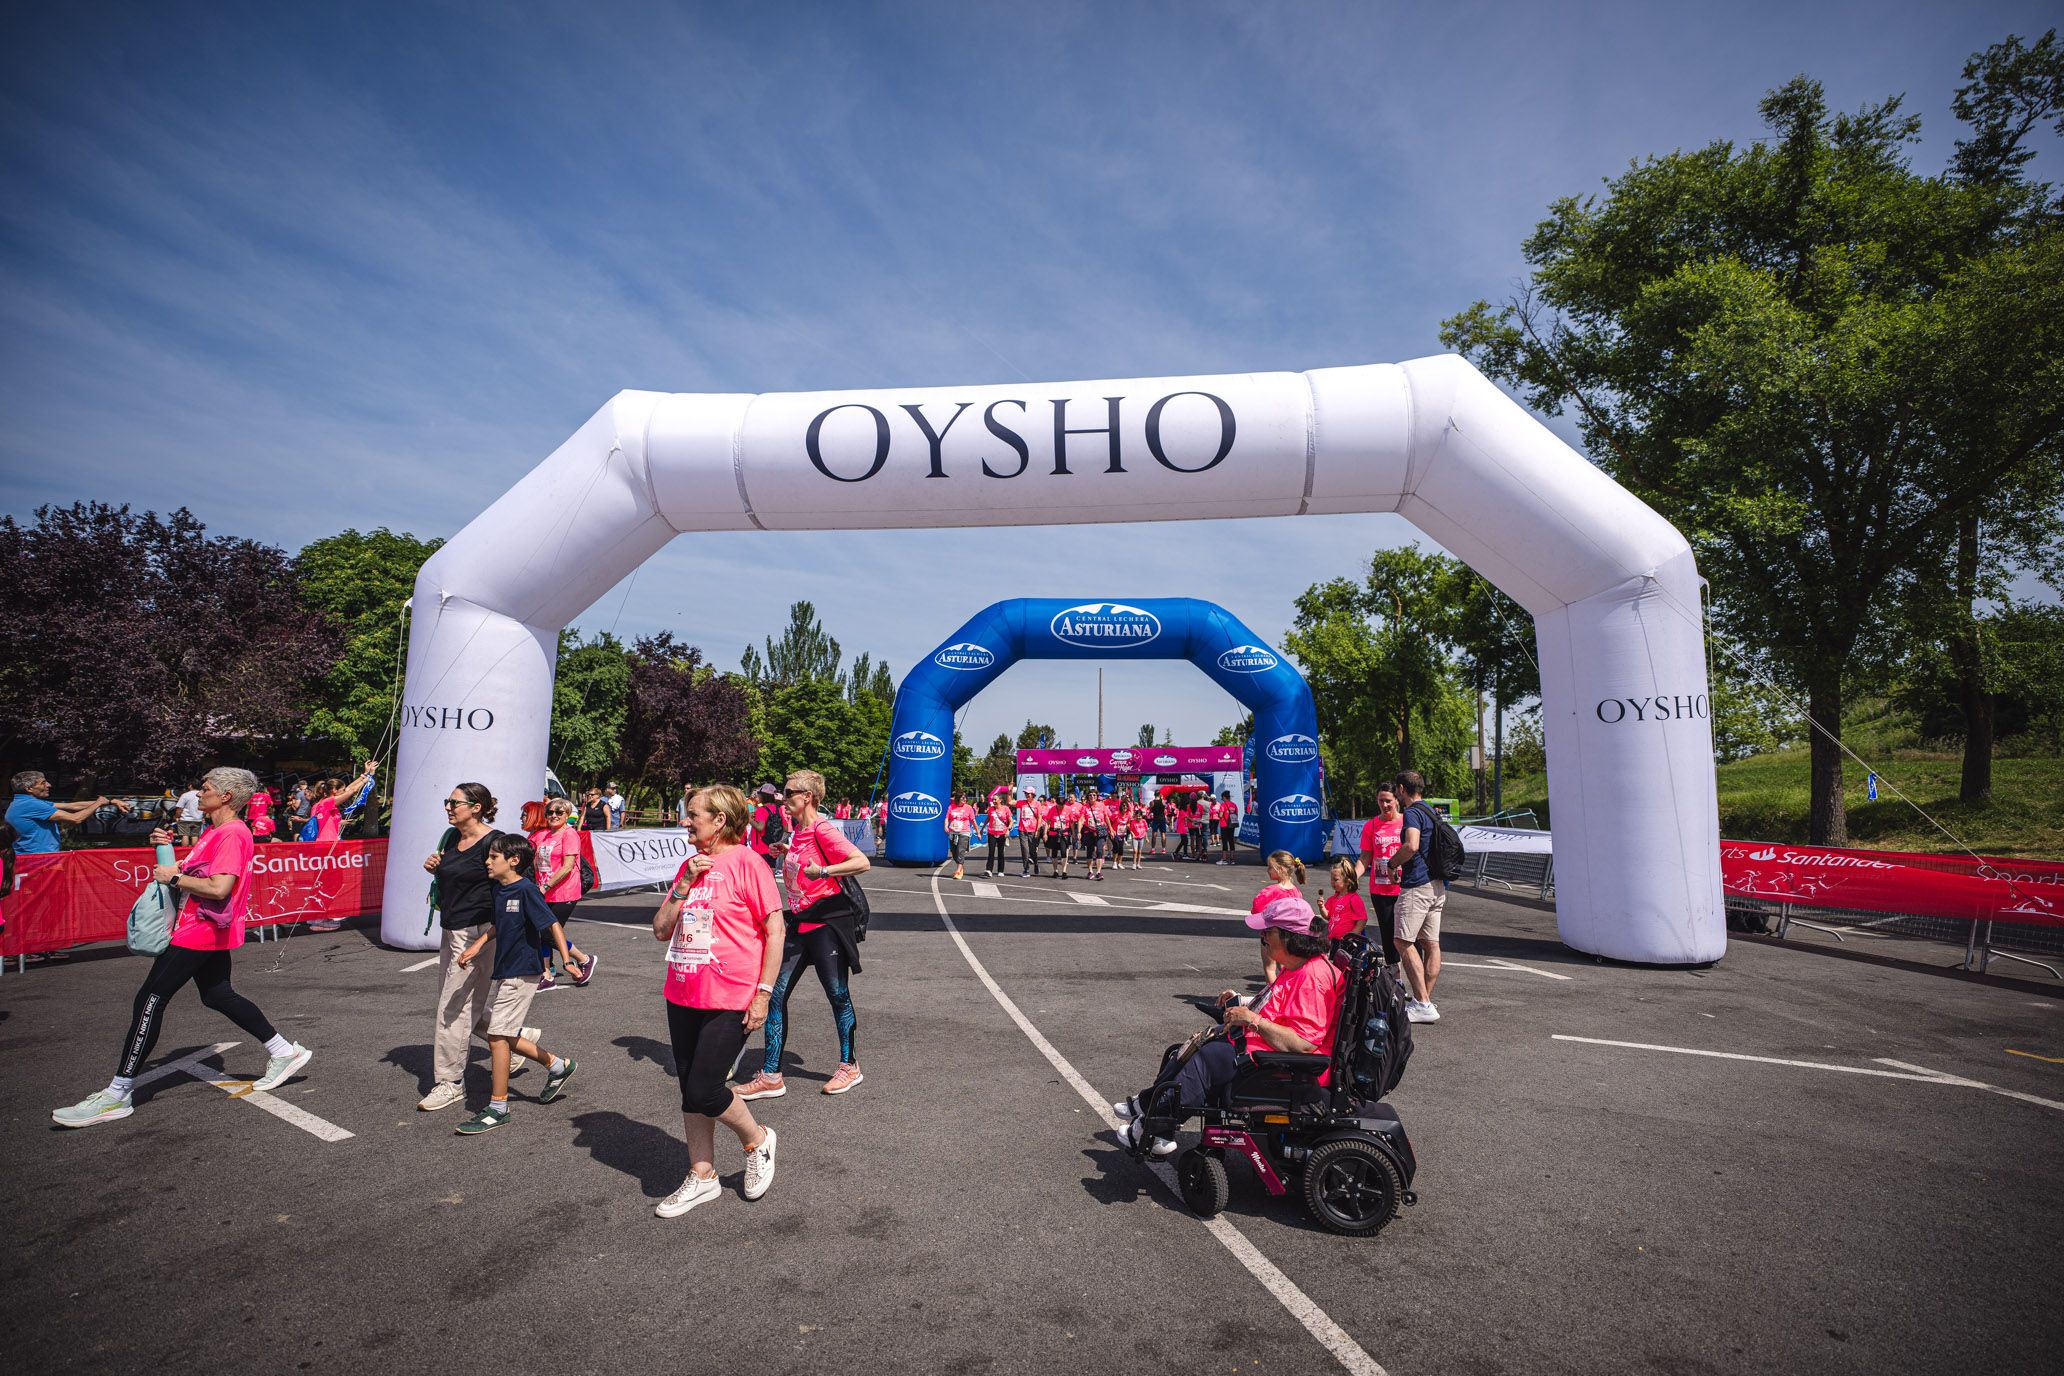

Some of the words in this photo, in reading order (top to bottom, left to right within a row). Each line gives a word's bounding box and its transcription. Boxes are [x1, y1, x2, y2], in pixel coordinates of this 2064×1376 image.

[806, 391, 1237, 482] OYSHO
[1059, 617, 1153, 637] ASTURIANA
[938, 653, 989, 664] ASTURIANA
[1223, 656, 1274, 667] ASTURIANA
[1596, 694, 1708, 724] OYSHO
[896, 741, 942, 754] ASTURIANA
[893, 801, 939, 815] ASTURIANA
[1375, 836, 1401, 845] CARRER
[618, 837, 687, 864] OYSHO
[1777, 851, 1905, 869] Santander
[252, 851, 372, 875] Santander
[126, 1055, 138, 1073] NIKE
[133, 1035, 144, 1055] NIKE
[139, 1016, 150, 1035] NIKE
[145, 996, 157, 1015] NIKE
